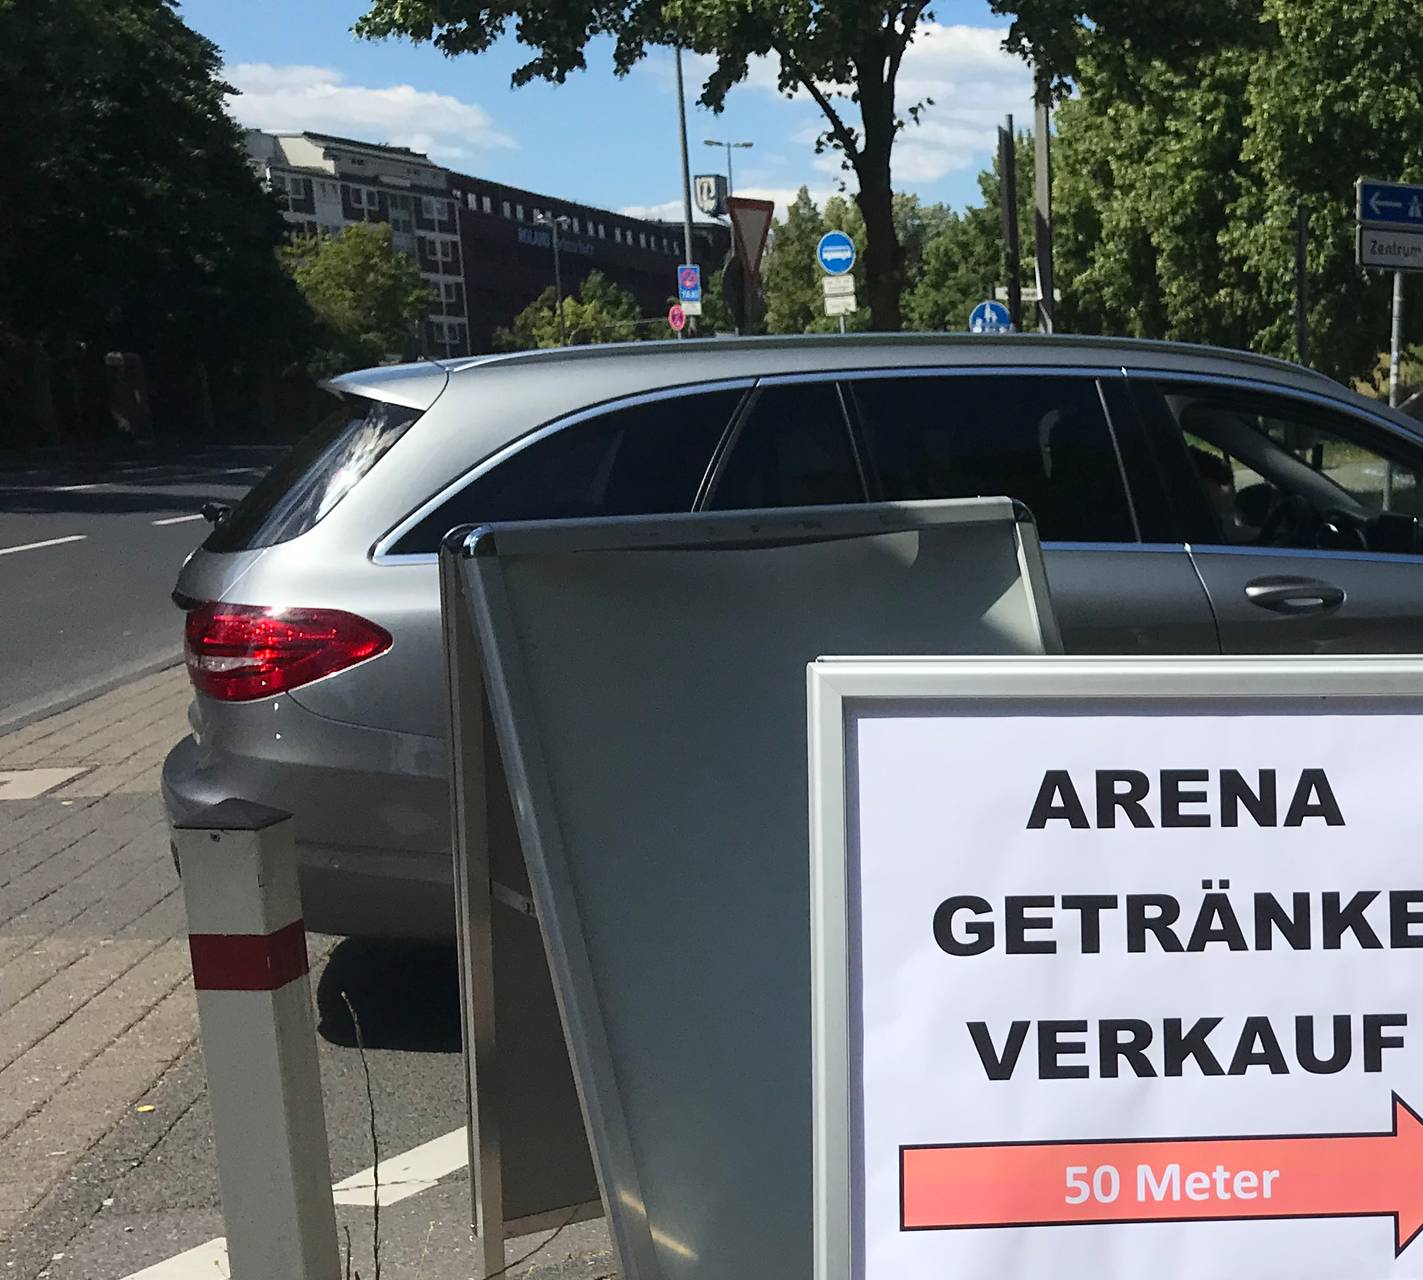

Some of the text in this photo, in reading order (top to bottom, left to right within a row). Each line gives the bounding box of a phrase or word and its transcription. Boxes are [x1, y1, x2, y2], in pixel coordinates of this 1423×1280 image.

[1369, 239, 1422, 257] Zentrum
[1026, 768, 1346, 830] ARENA
[966, 1013, 1408, 1081] VERKAUF
[1064, 1163, 1280, 1204] 50 Meter
